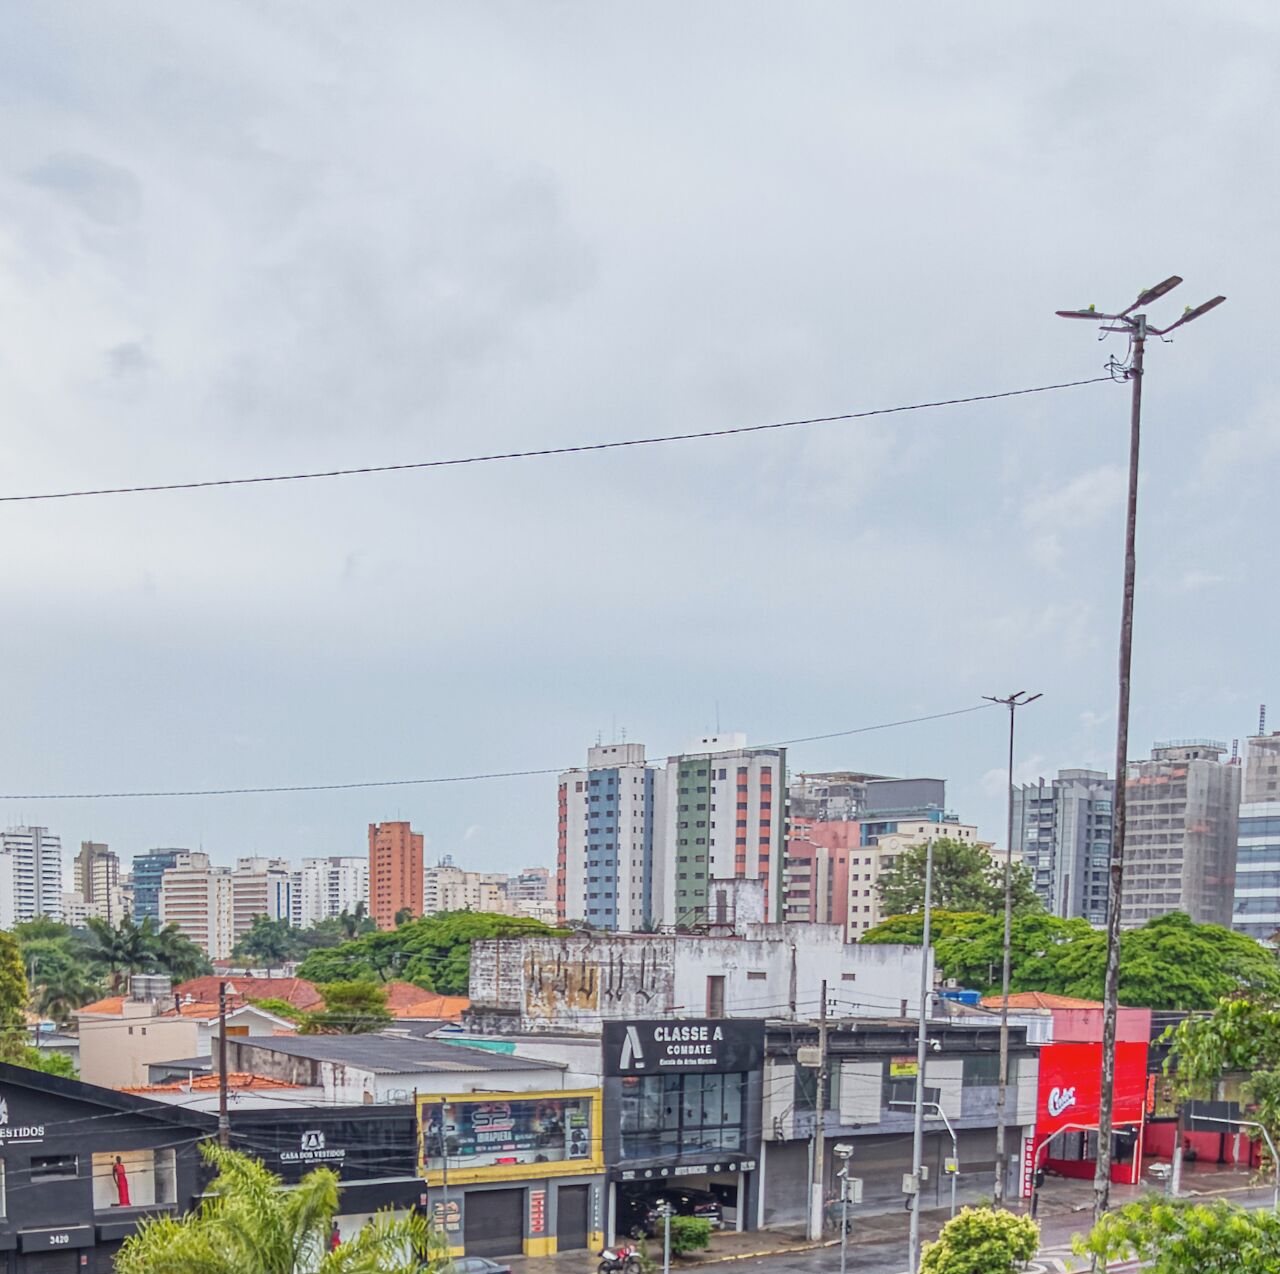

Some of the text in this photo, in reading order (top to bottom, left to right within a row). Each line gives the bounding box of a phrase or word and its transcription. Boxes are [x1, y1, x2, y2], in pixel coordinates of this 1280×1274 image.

[654, 1026, 724, 1042] CLASSE A
[666, 1044, 712, 1055] COMBATE
[280, 1148, 345, 1160] CASA DOS VESTIDOS
